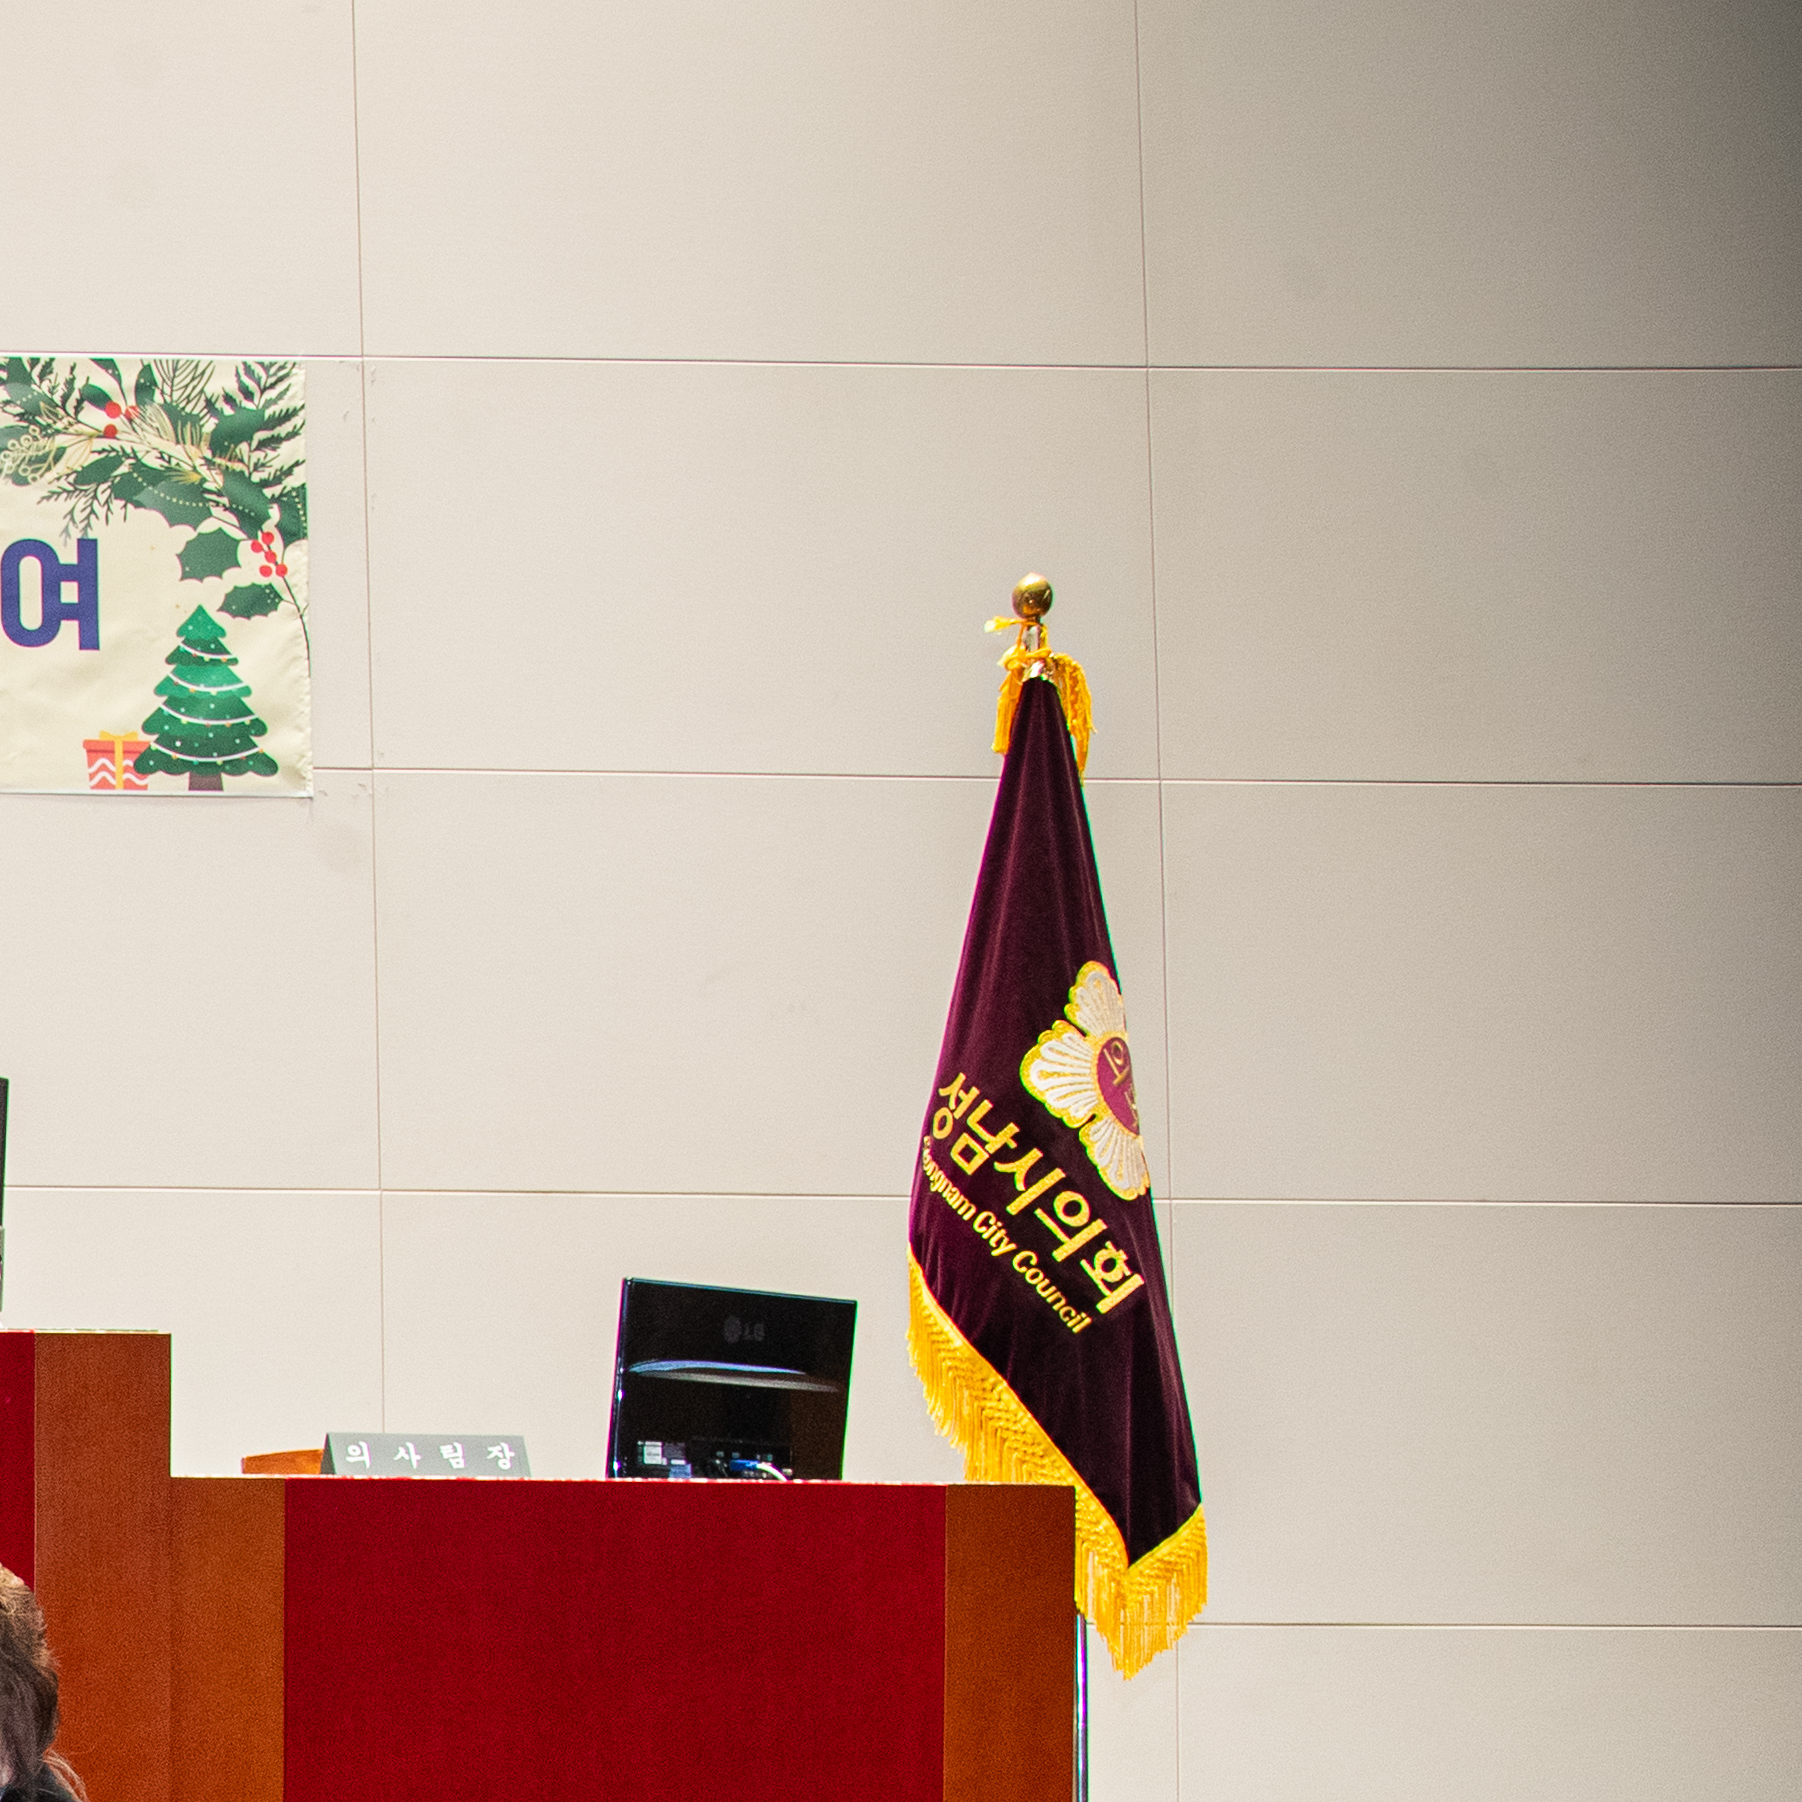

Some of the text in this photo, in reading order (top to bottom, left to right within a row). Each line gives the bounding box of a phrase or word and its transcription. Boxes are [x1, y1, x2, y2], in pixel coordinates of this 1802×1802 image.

[933, 1072, 1145, 1314] 성남시의회
[973, 1211, 1017, 1256] City
[1013, 1250, 1092, 1334] Council
